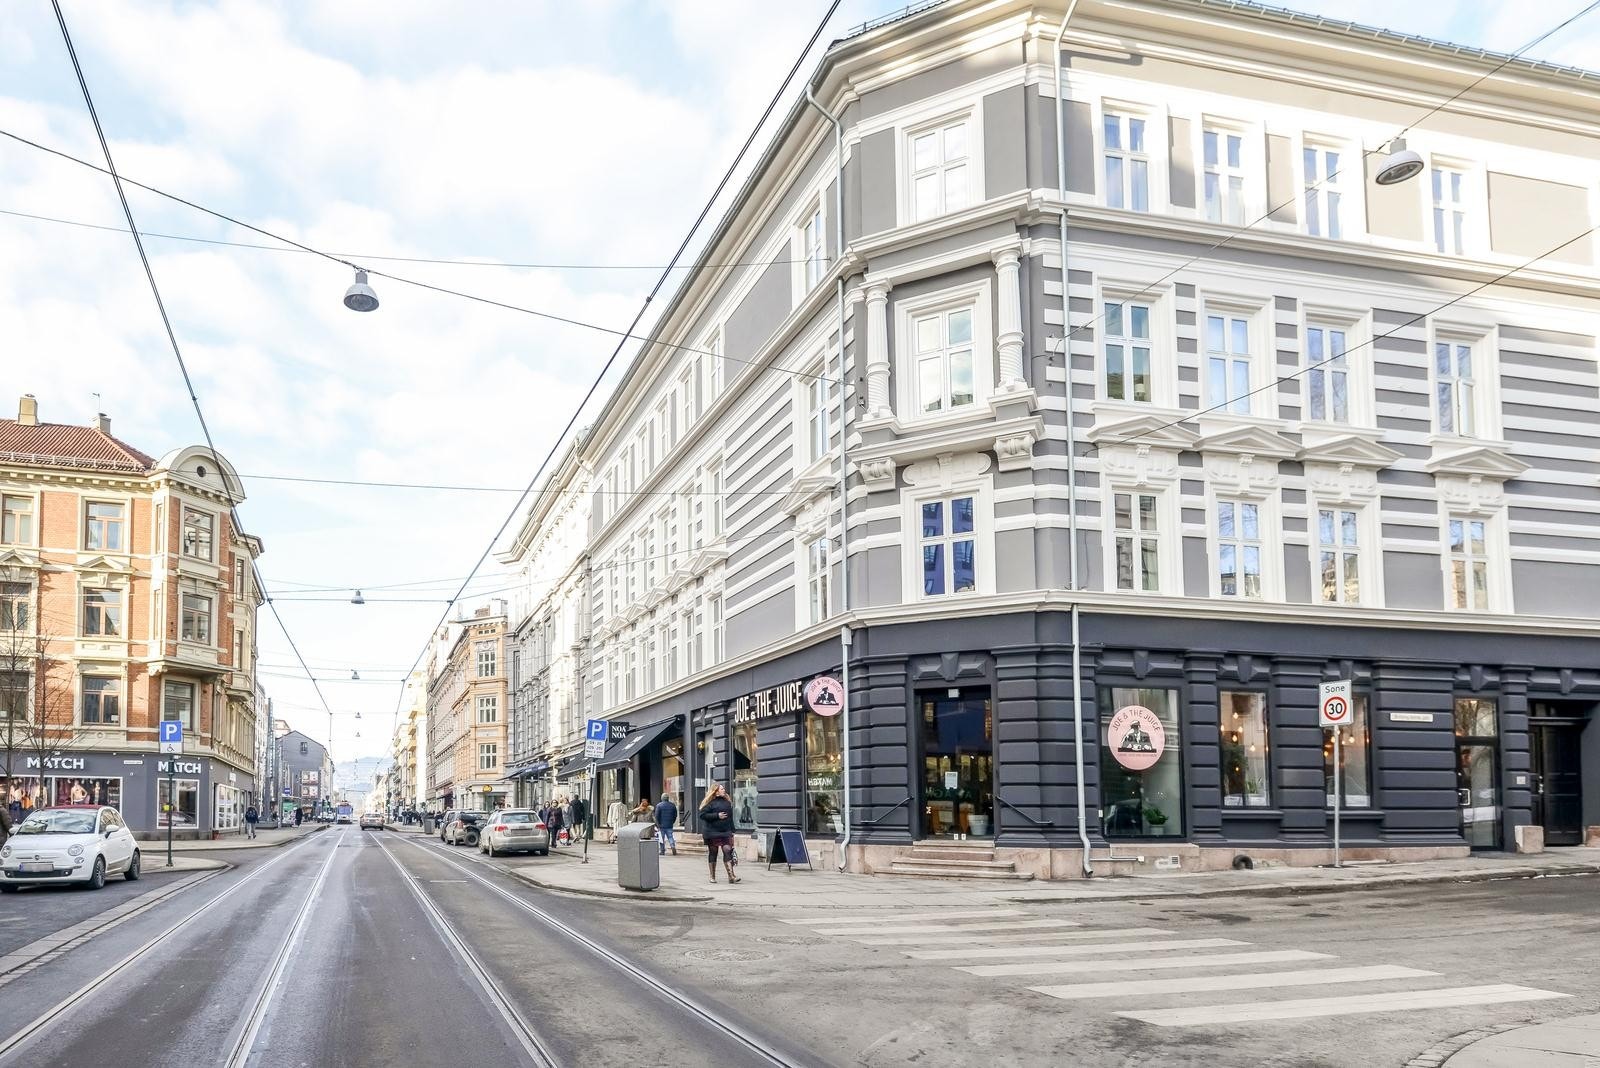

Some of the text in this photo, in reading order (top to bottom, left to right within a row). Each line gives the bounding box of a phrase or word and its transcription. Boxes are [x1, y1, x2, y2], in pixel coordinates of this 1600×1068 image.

[1325, 685, 1345, 693] Sone
[735, 681, 803, 723] JOE & THE JUICE
[1328, 703, 1343, 715] 30
[1112, 717, 1124, 731] JOE
[1129, 709, 1143, 717] THE
[1144, 713, 1161, 733] JUICE
[166, 723, 177, 740] P
[591, 722, 602, 737] P
[26, 757, 84, 769] MATCH
